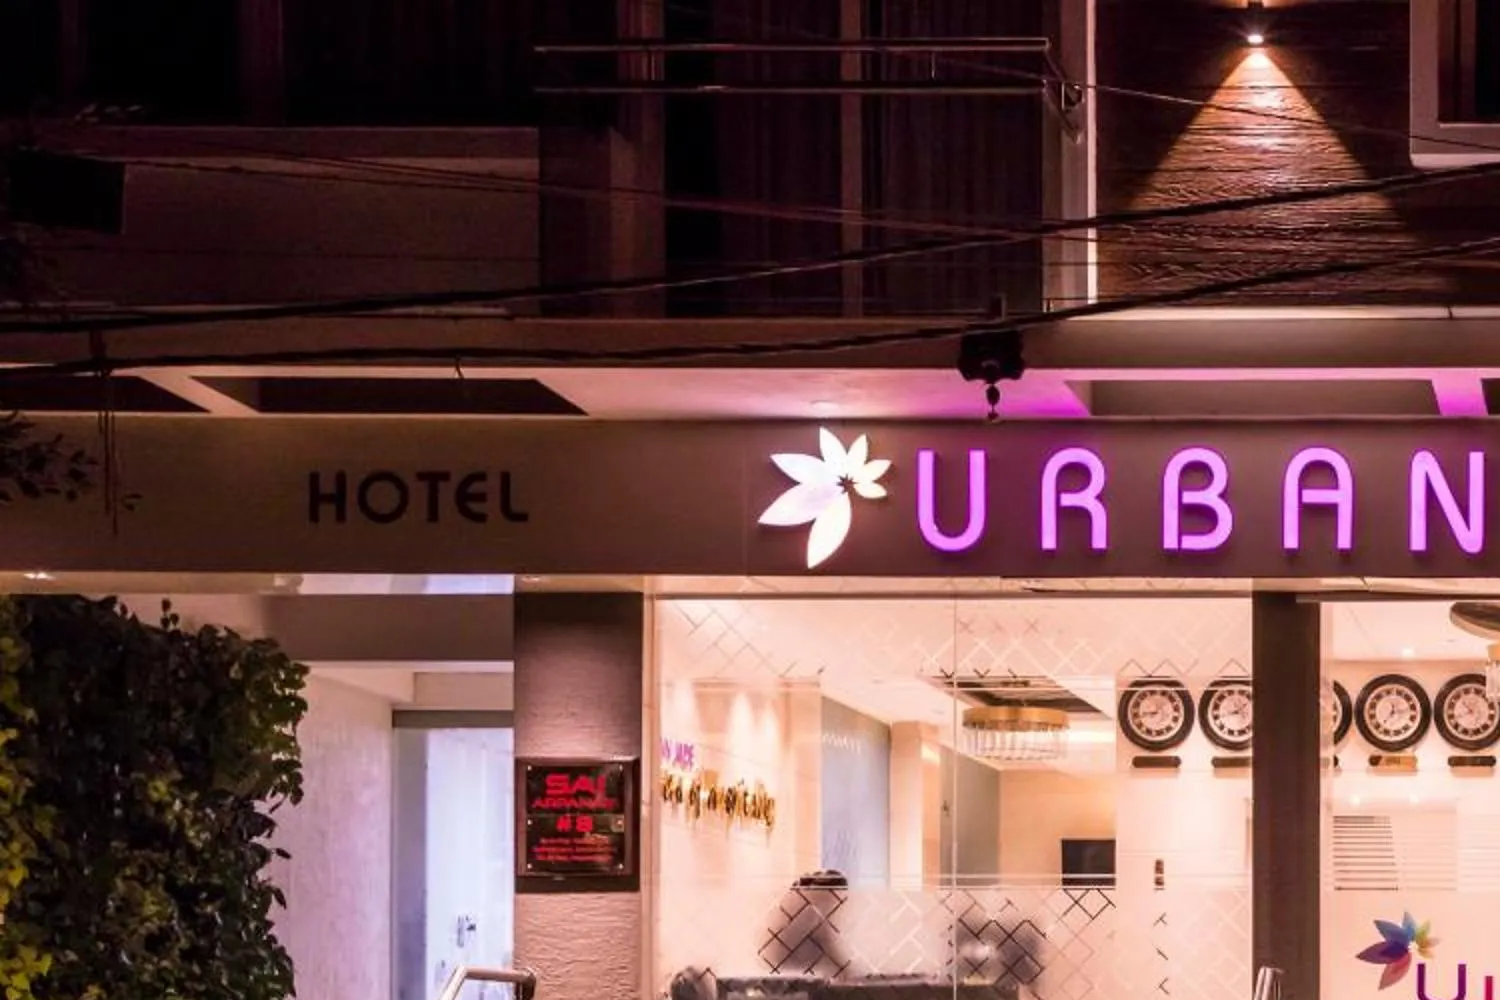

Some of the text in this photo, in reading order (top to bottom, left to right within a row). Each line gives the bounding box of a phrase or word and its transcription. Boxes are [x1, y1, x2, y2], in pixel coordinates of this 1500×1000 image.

[307, 470, 529, 524] HOTEL
[915, 447, 1485, 553] URBAN
[545, 774, 609, 796] SAI
